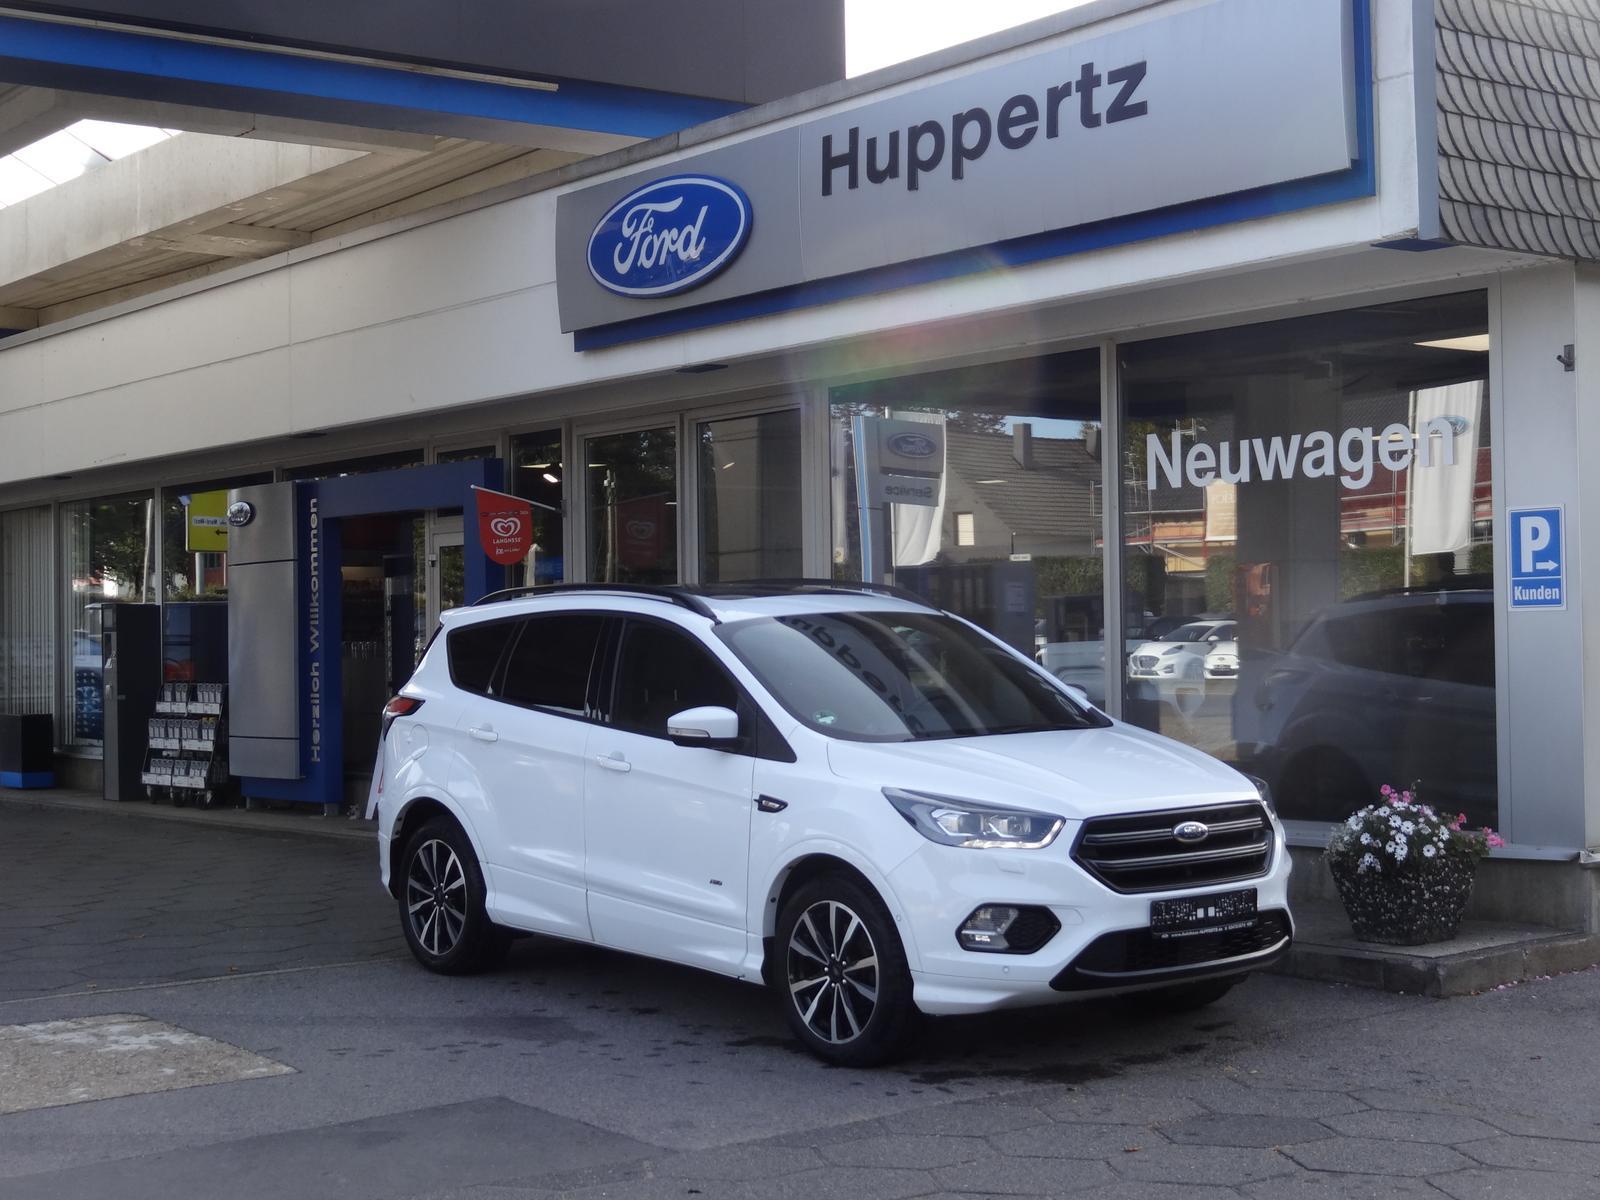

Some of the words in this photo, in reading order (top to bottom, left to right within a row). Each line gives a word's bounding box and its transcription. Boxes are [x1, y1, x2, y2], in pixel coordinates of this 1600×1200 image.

[822, 60, 1148, 196] Huppertz
[613, 196, 708, 275] Ford
[1146, 417, 1455, 490] Neuwagen
[309, 497, 321, 653] Willkommen
[1520, 516, 1550, 573] P
[1514, 585, 1560, 601] Kunden
[310, 661, 321, 763] Herzlich
